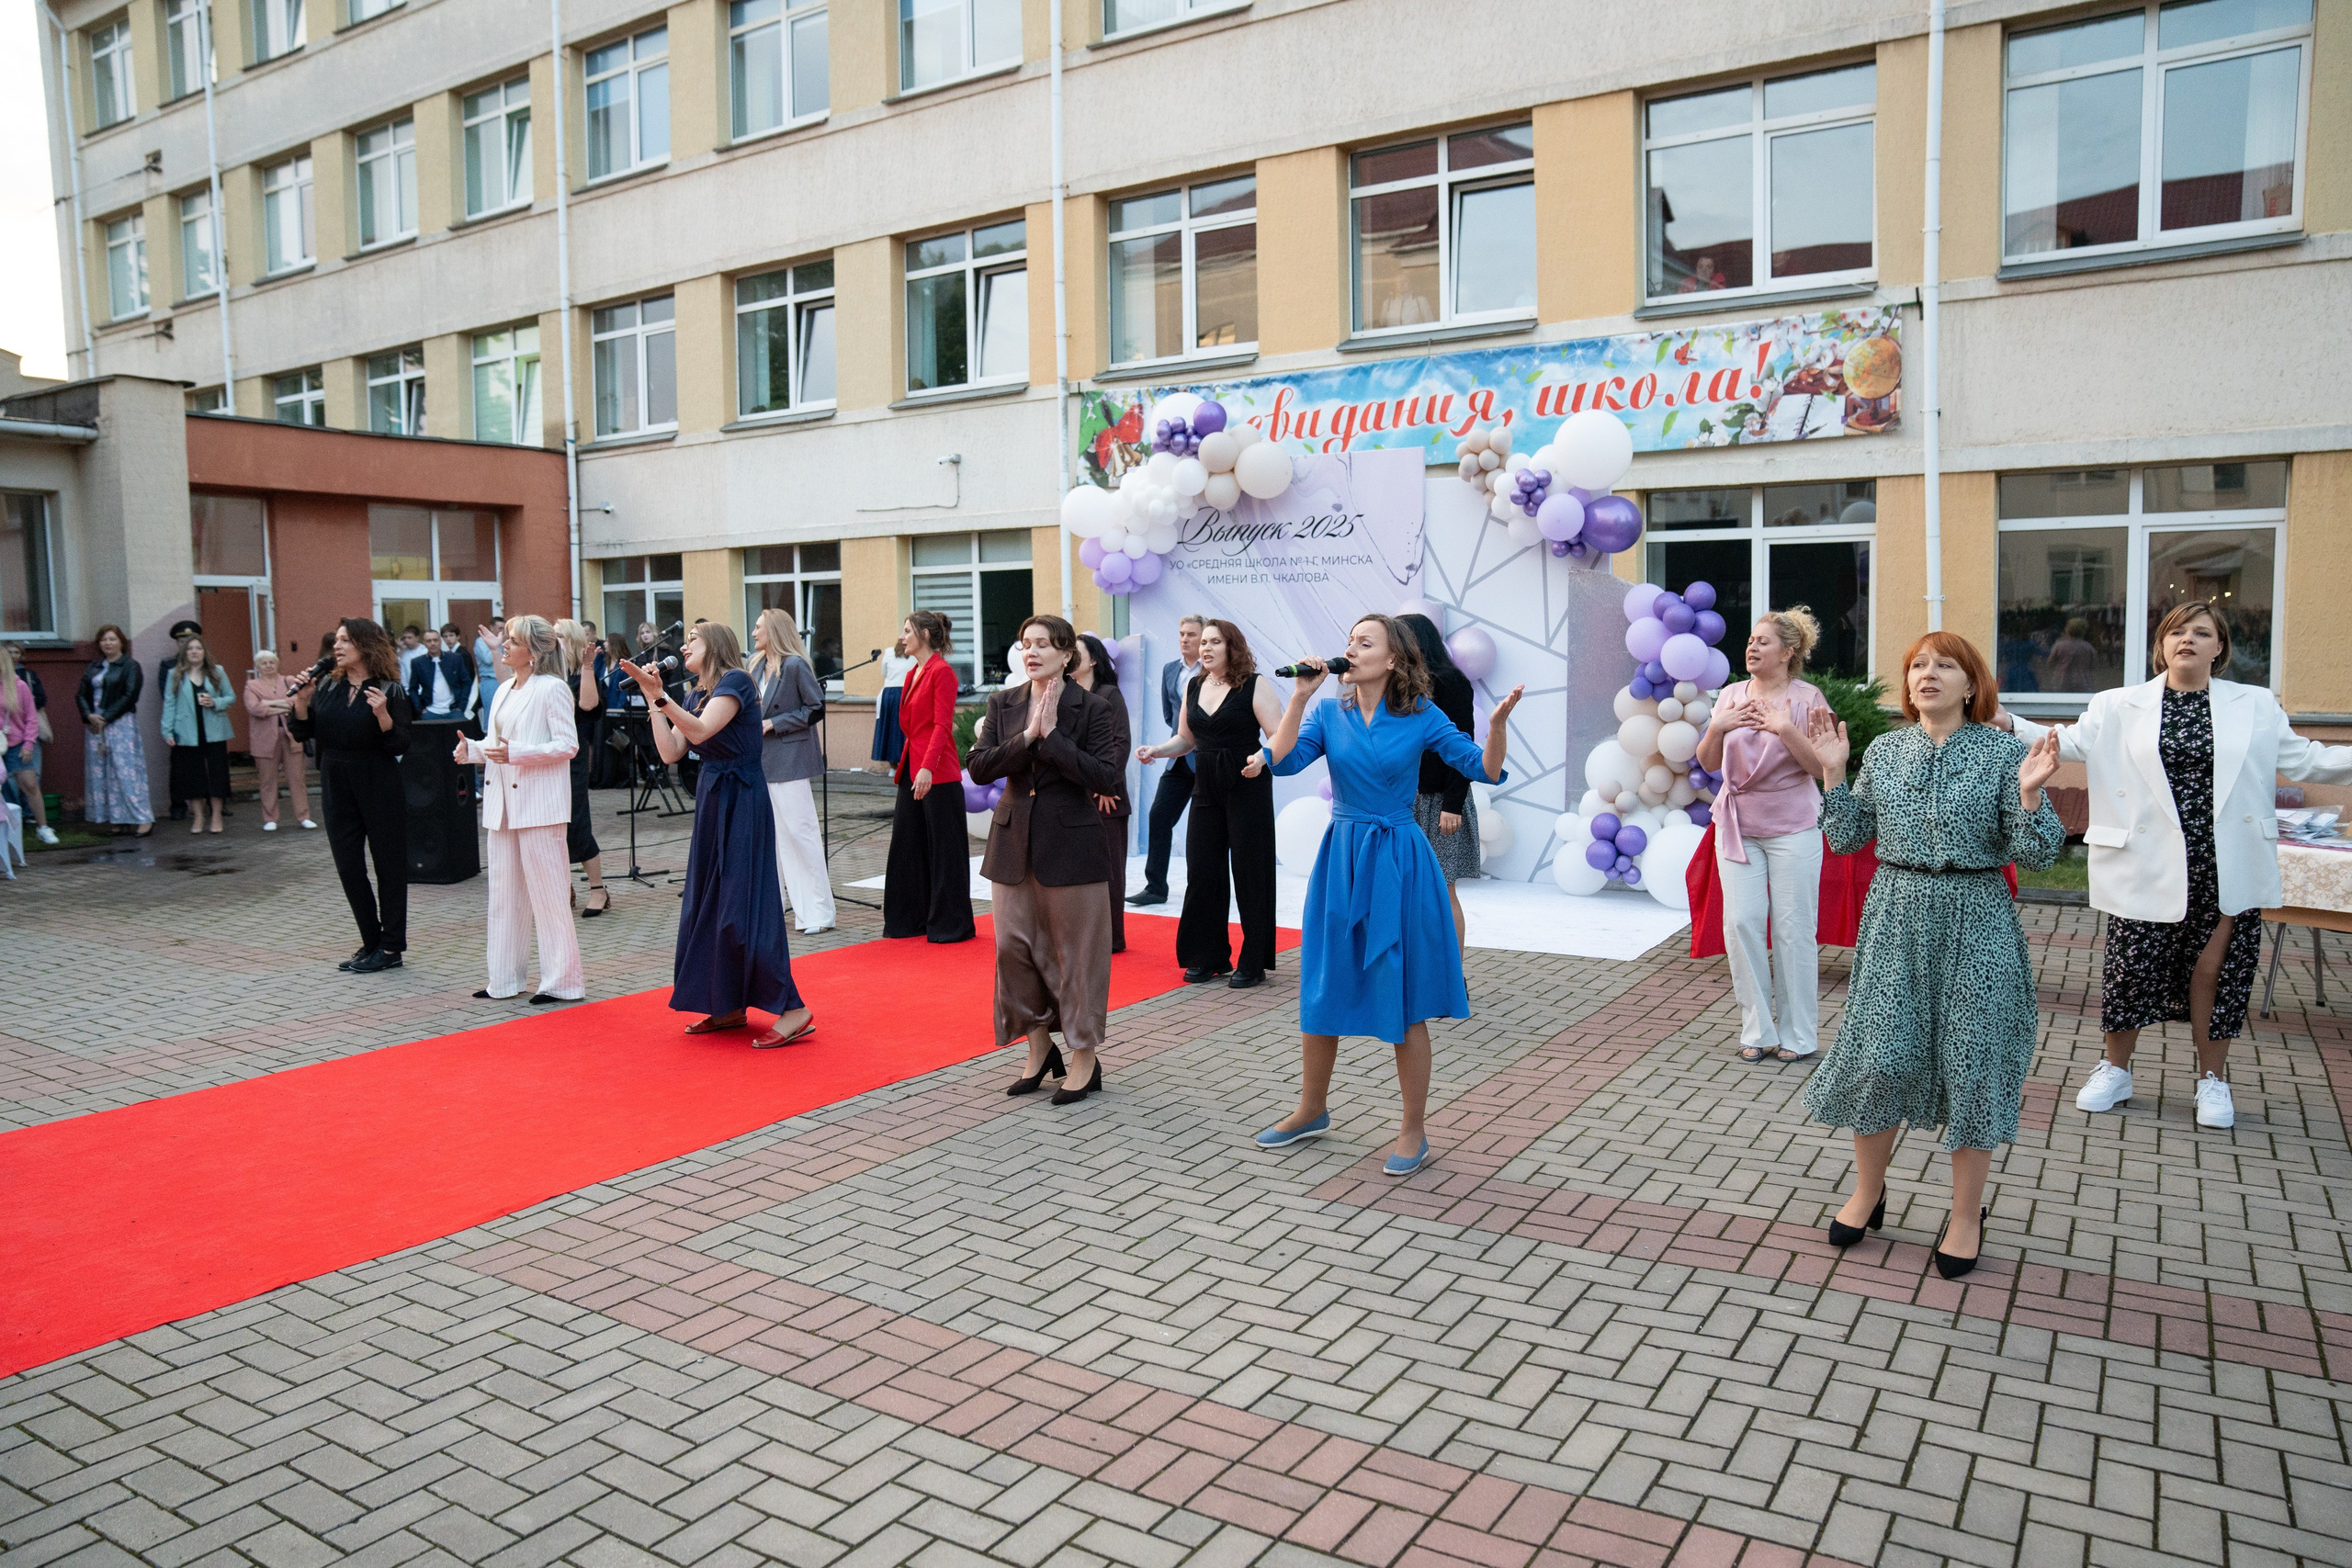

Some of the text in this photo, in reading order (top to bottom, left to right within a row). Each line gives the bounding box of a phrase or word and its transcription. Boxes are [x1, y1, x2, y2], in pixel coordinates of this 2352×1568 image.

[1535, 341, 1772, 417] школа!
[1177, 506, 1364, 557] Выпуск 2025
[1170, 559, 1185, 570] УО
[1187, 558, 1242, 570] «СРЕДНЯЯ
[1245, 557, 1287, 569] ШКОЛА
[1321, 554, 1374, 566] МИНСКА
[1207, 571, 1330, 584] ИМЕНИ В.П. ЧКАЛОВА
